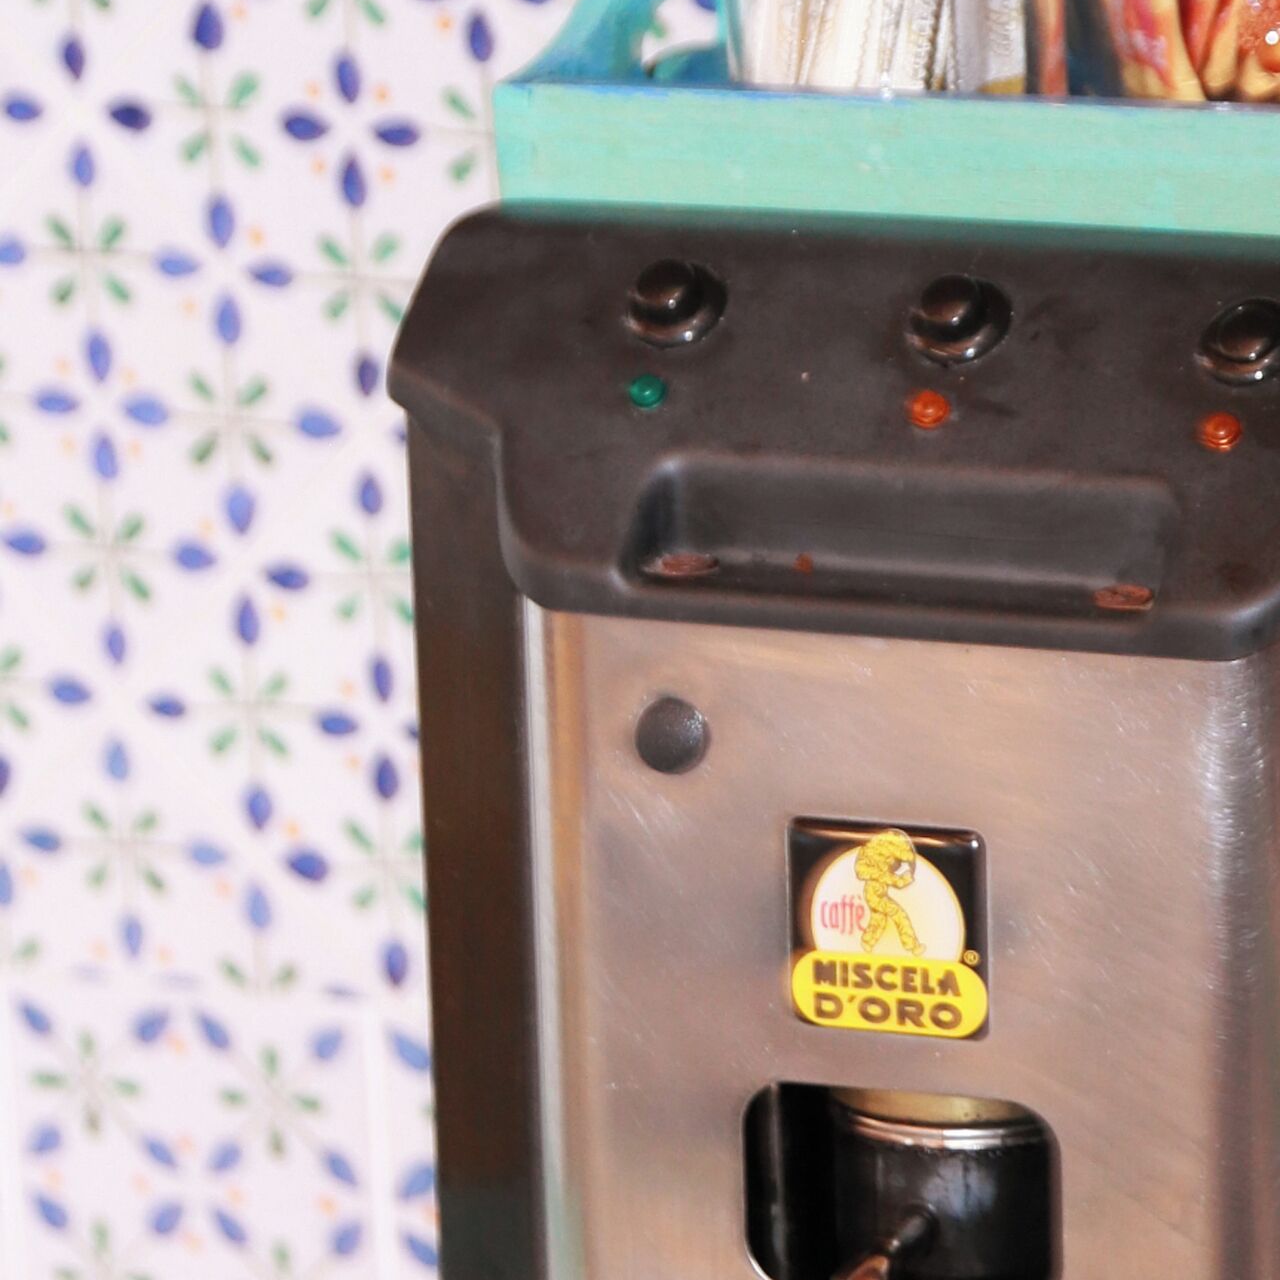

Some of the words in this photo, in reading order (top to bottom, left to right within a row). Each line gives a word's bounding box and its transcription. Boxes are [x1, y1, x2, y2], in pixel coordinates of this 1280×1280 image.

[820, 895, 866, 935] caffè
[813, 960, 962, 997] MISCELA
[814, 992, 962, 1029] D'ORO
